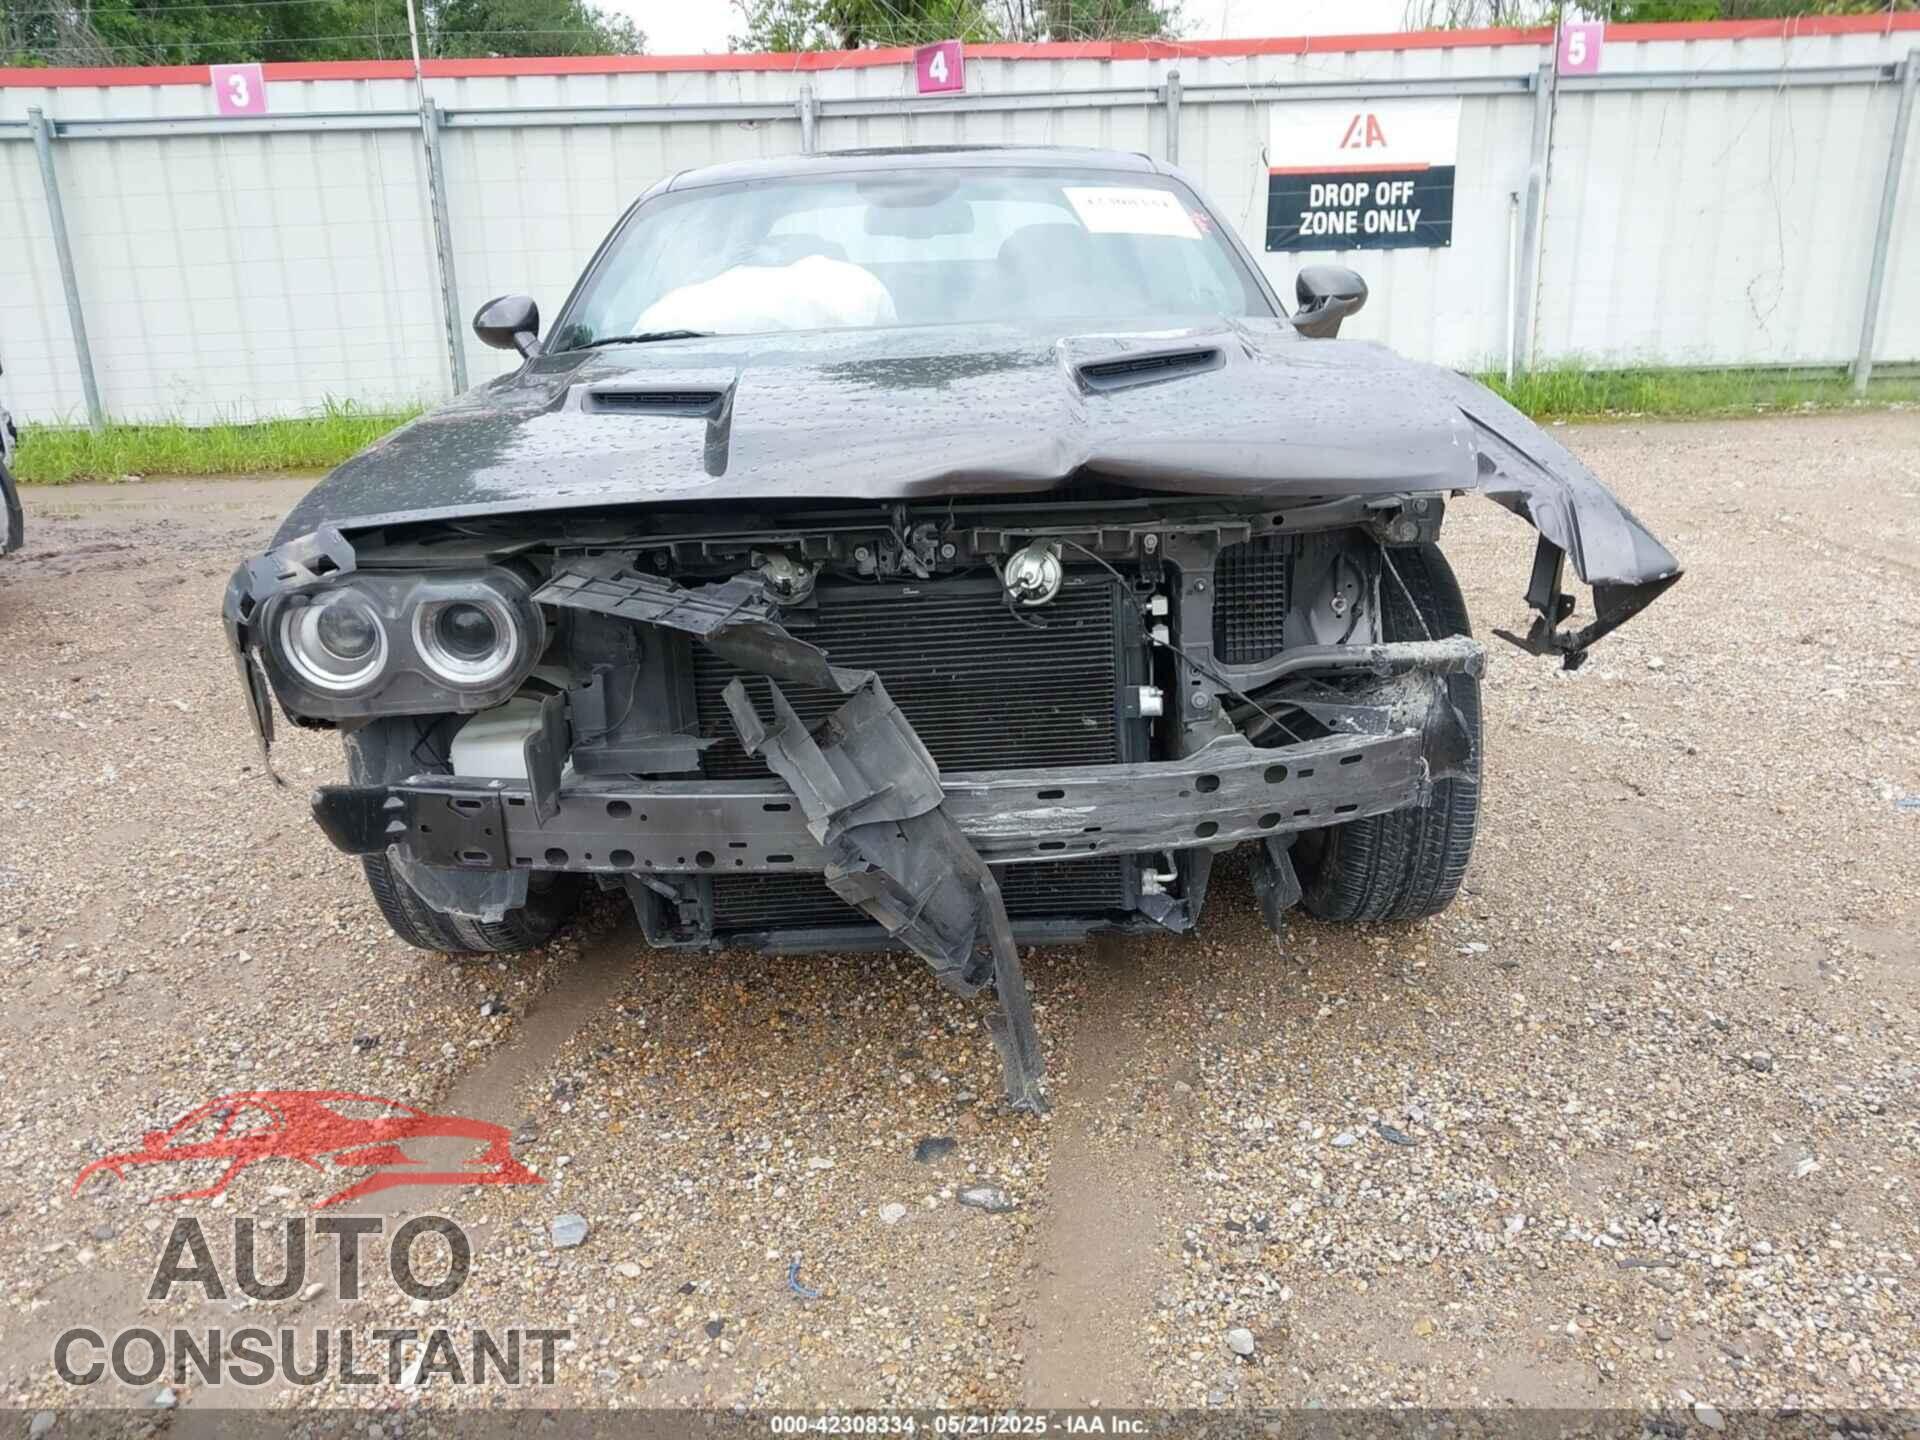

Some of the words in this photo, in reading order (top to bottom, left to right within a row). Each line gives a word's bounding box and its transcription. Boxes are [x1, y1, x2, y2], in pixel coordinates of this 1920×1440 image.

[1568, 32, 1586, 64] 5
[929, 51, 948, 83] 4
[229, 75, 248, 107] 3
[1310, 183, 1369, 207] DROP
[1375, 181, 1414, 205] OFF
[1299, 211, 1359, 235] ZONE
[1364, 209, 1420, 233] ONLY
